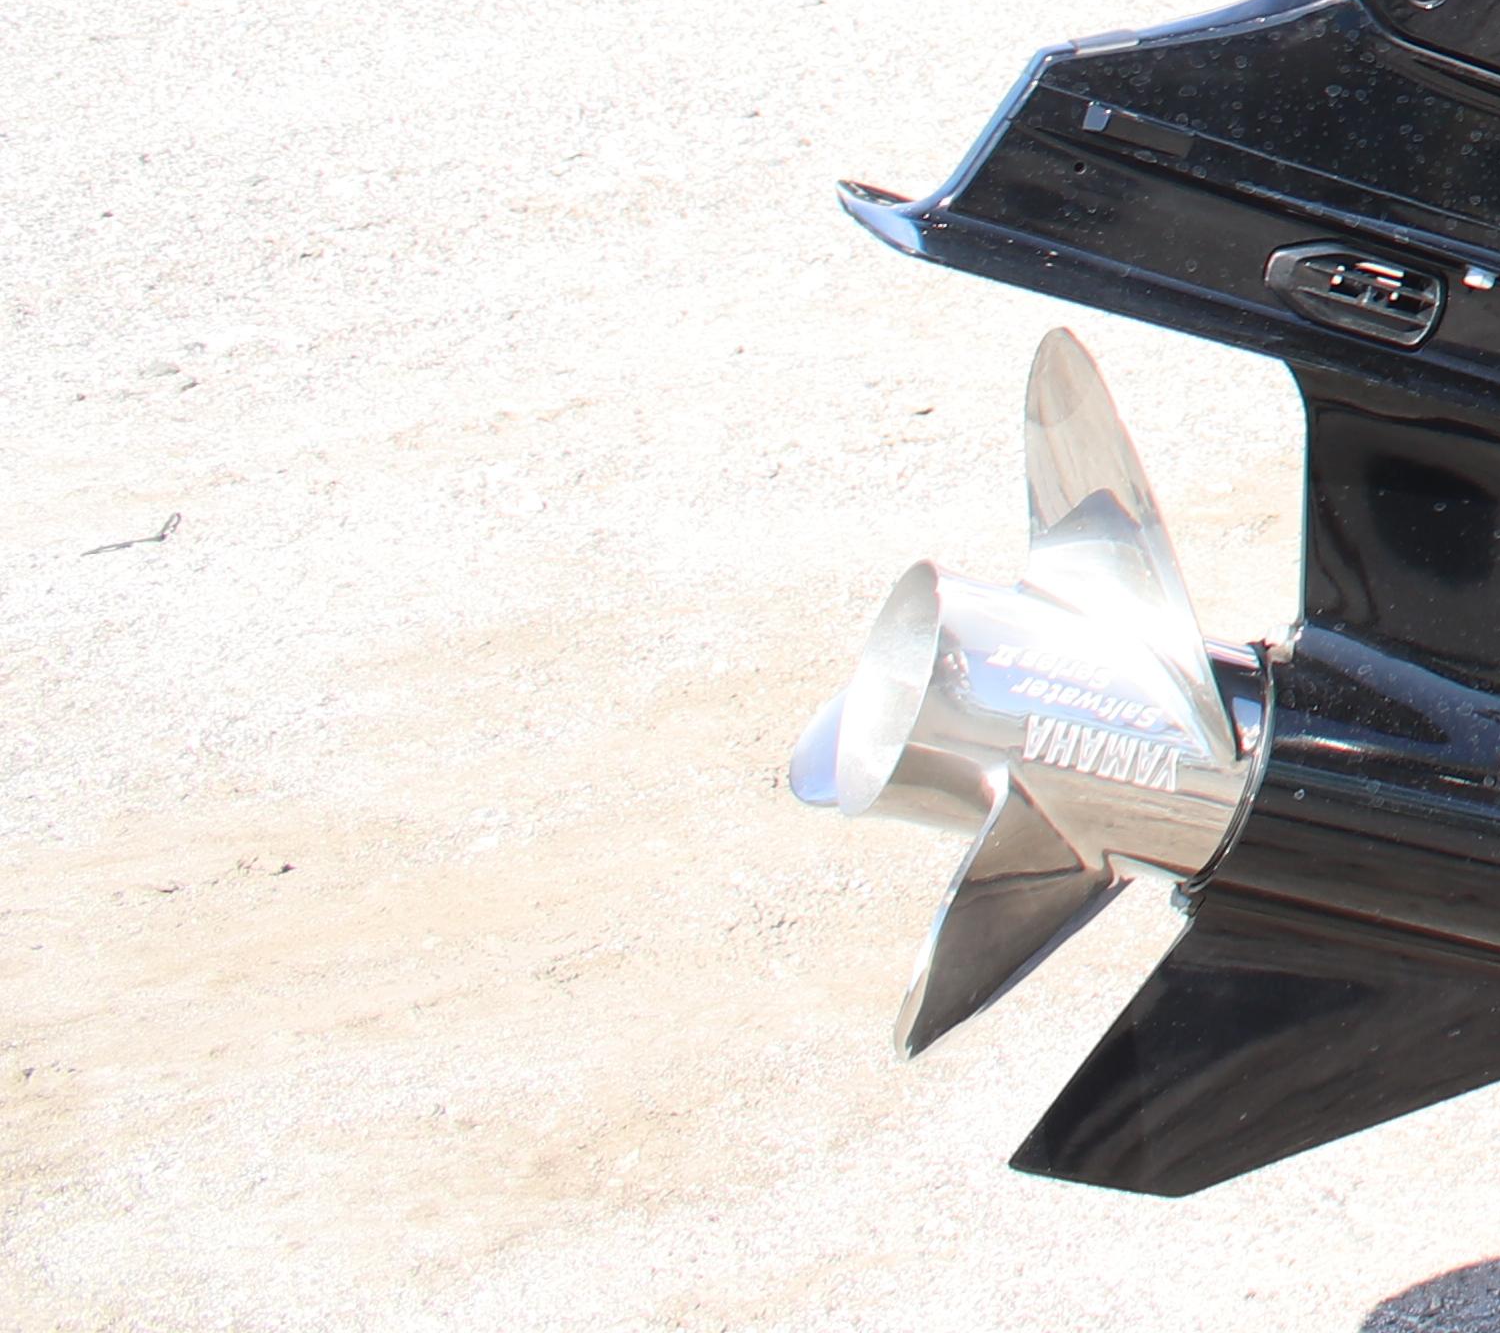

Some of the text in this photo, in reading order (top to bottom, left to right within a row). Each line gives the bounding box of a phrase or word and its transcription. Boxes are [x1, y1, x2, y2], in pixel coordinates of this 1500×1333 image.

[1017, 647, 1112, 690] Series
[1010, 675, 1166, 727] Saltwater
[1021, 714, 1181, 793] YAMAHA
